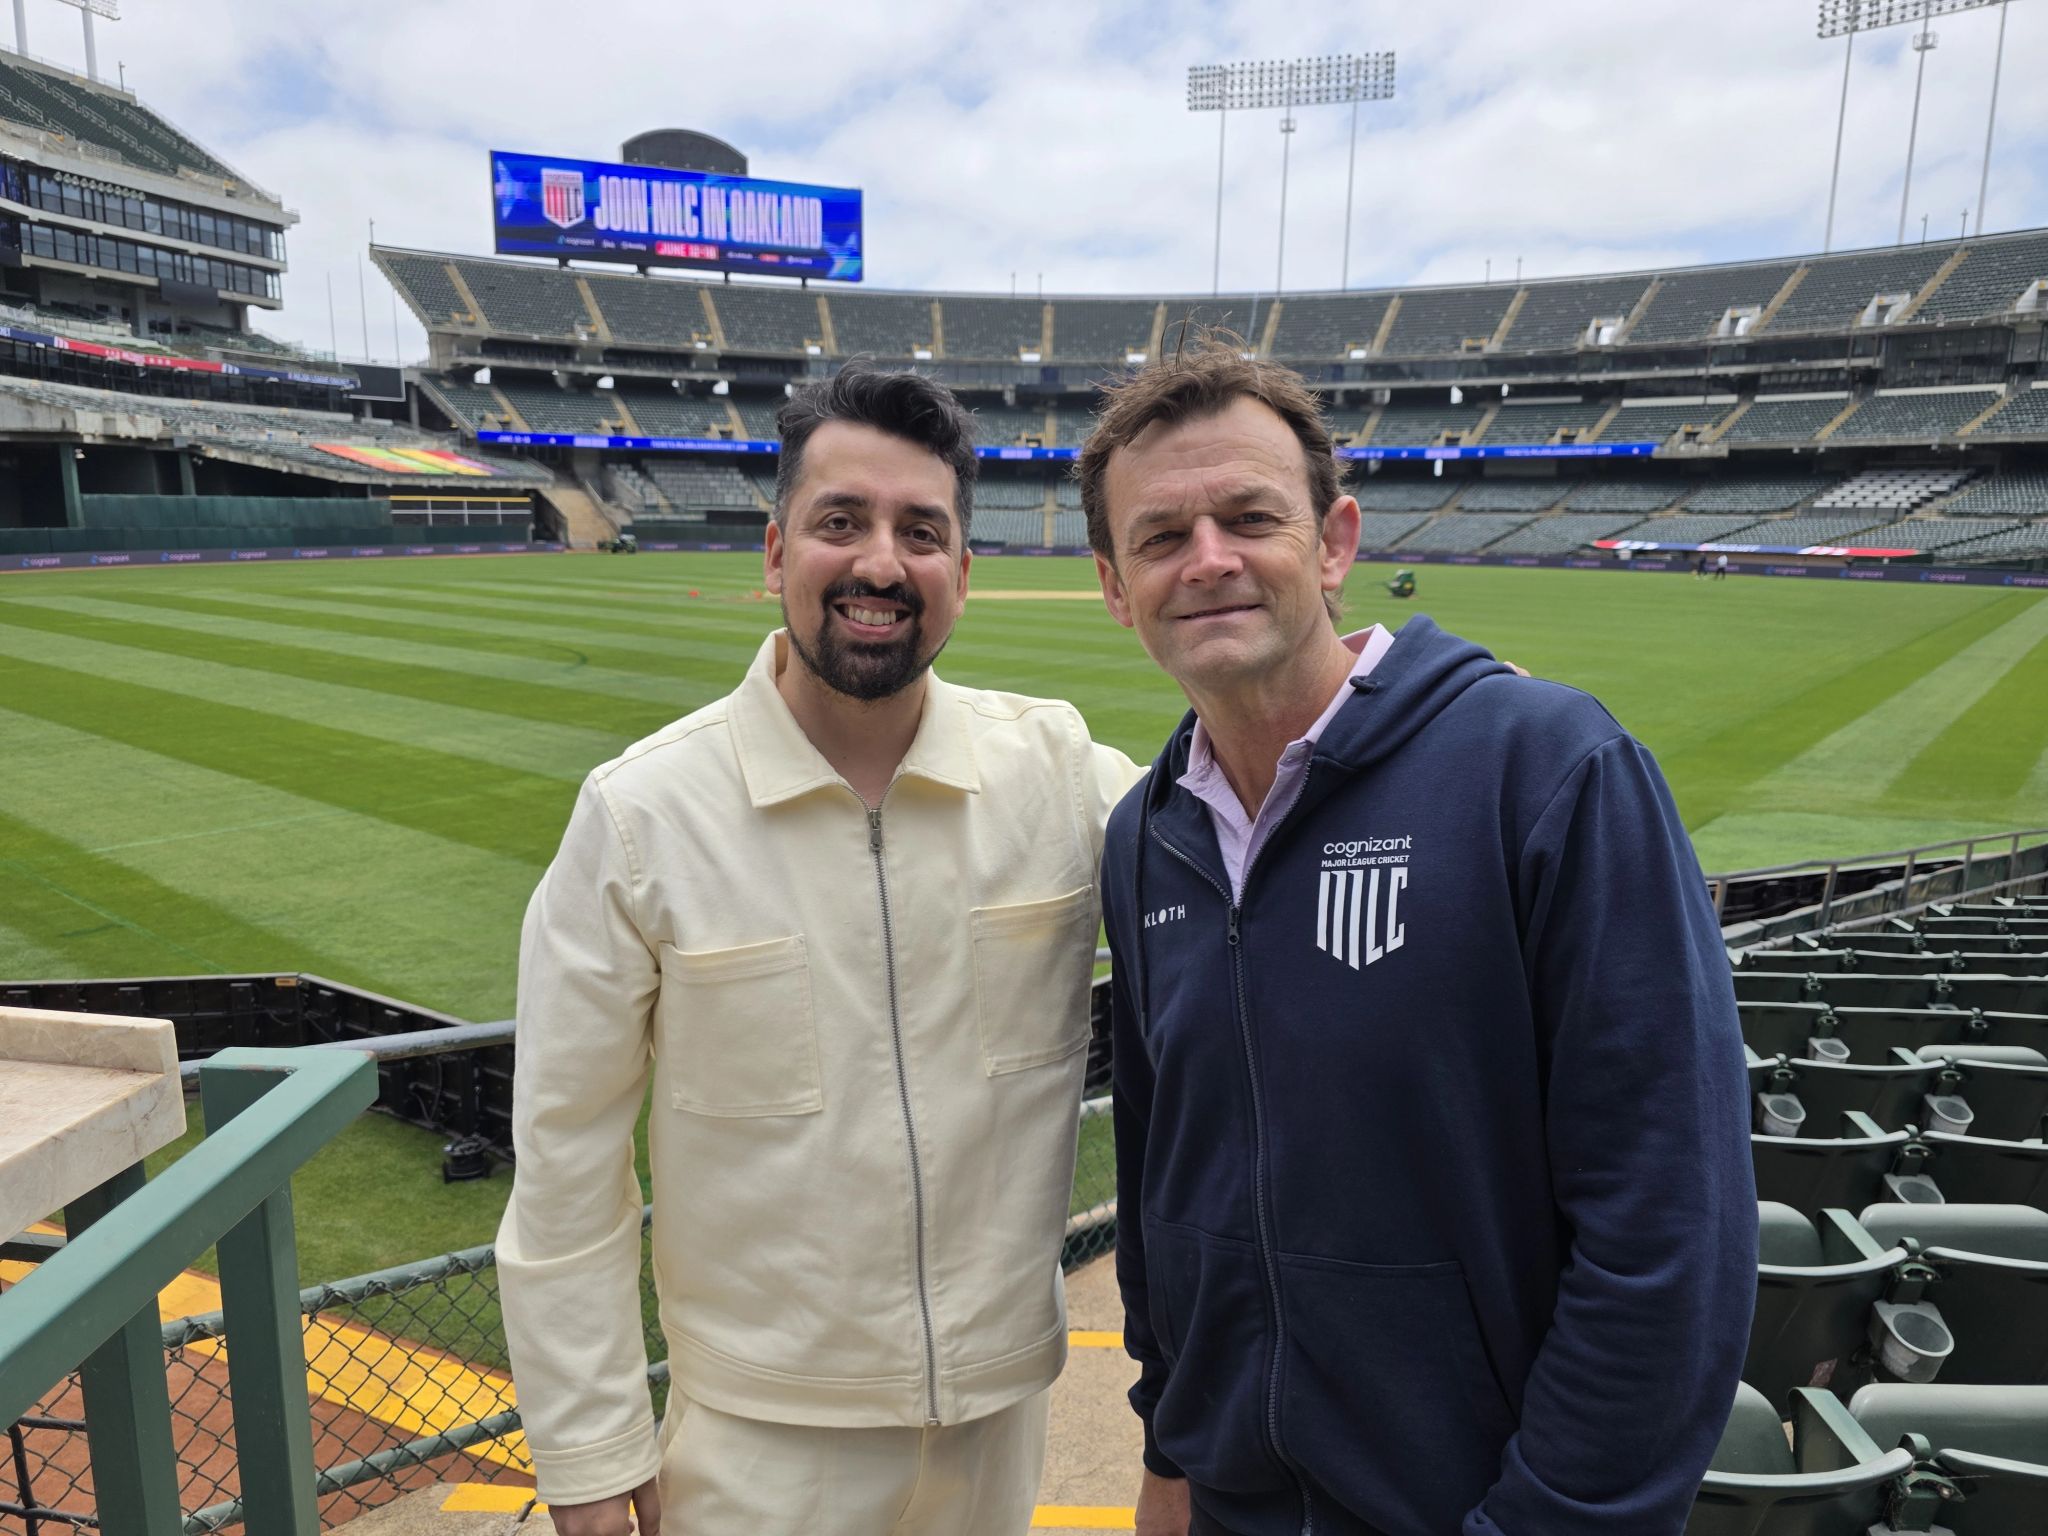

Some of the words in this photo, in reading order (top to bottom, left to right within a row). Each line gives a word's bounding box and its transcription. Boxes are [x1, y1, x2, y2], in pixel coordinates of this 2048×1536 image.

[594, 175, 649, 233] JOIN
[651, 180, 699, 238] MLC
[702, 184, 727, 241] IN
[730, 189, 823, 249] OAKLAND
[659, 241, 686, 257] JUNE
[1323, 835, 1413, 858] cognizant
[1321, 859, 1347, 868] MAJOR
[1347, 857, 1377, 867] LEAGUE
[1377, 855, 1410, 865] CRICKET
[1144, 904, 1186, 929] KLOTH
[1317, 867, 1408, 971] MLC
